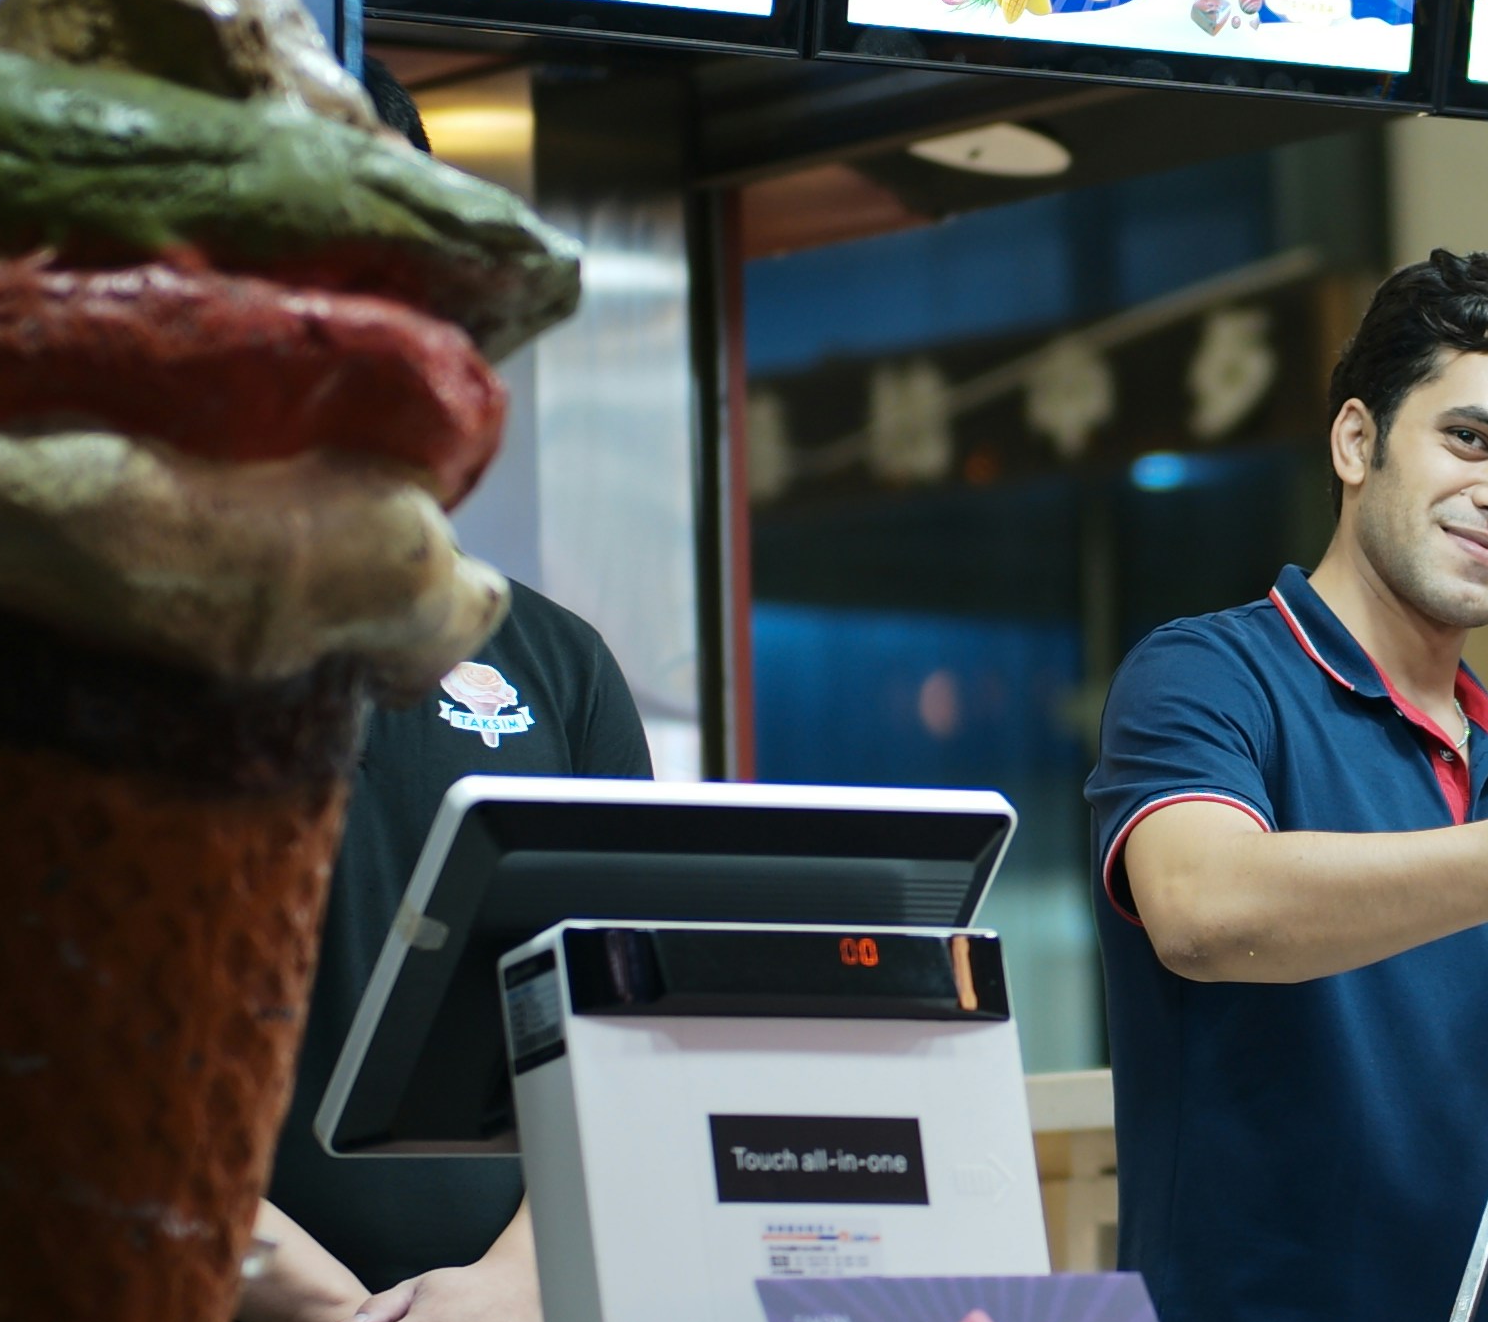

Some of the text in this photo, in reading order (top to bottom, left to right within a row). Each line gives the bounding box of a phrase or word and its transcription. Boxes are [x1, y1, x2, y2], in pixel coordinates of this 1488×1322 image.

[458, 714, 521, 730] TAKSIM
[729, 1145, 908, 1174] Touch all-in-one
